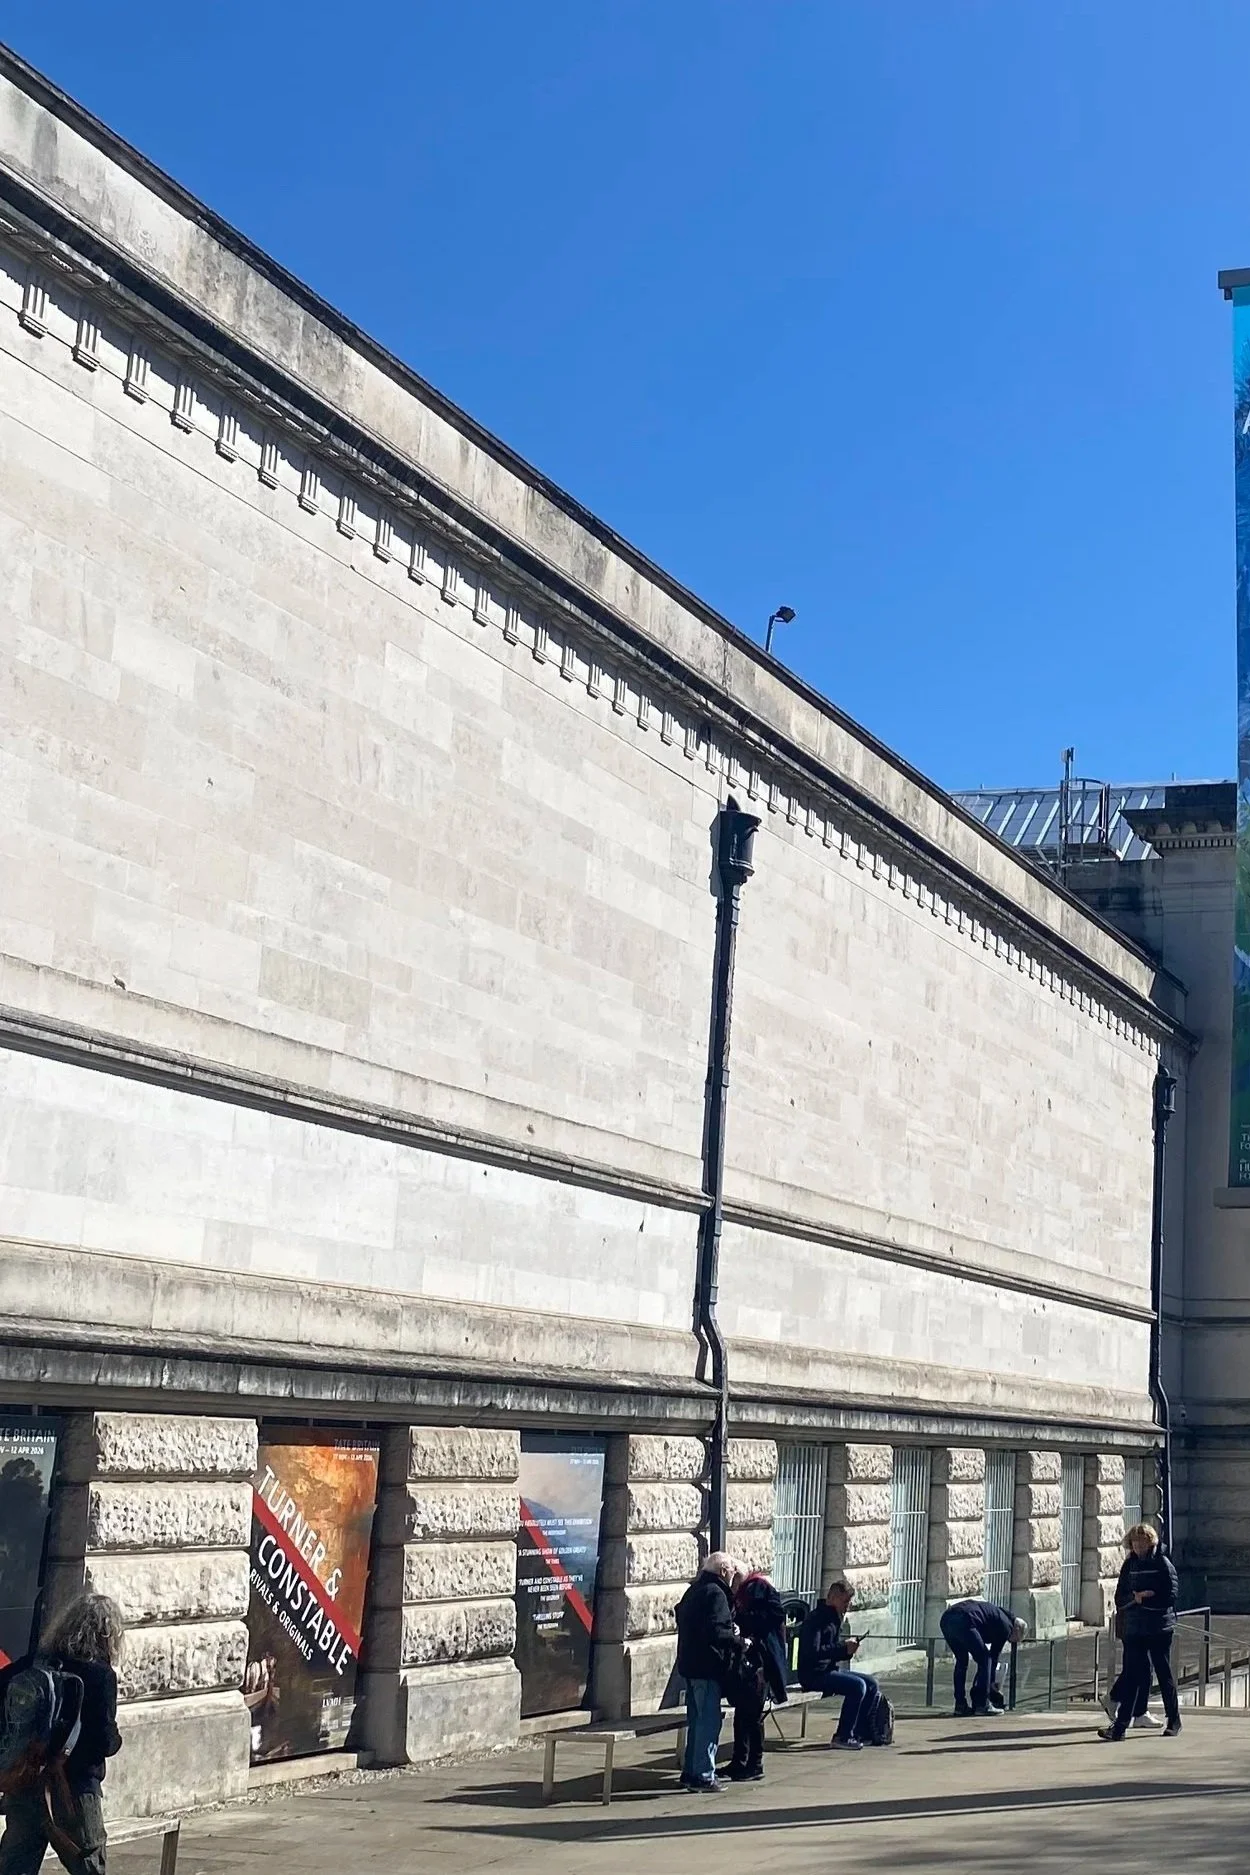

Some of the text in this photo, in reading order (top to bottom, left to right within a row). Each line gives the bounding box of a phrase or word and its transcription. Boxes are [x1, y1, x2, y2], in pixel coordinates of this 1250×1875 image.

[12, 1428, 55, 1443] BRITAIN
[257, 1465, 342, 1601] TURNER &
[250, 1568, 314, 1661] RIVALS & ORIGINALS
[258, 1534, 352, 1676] CONSTABLE
